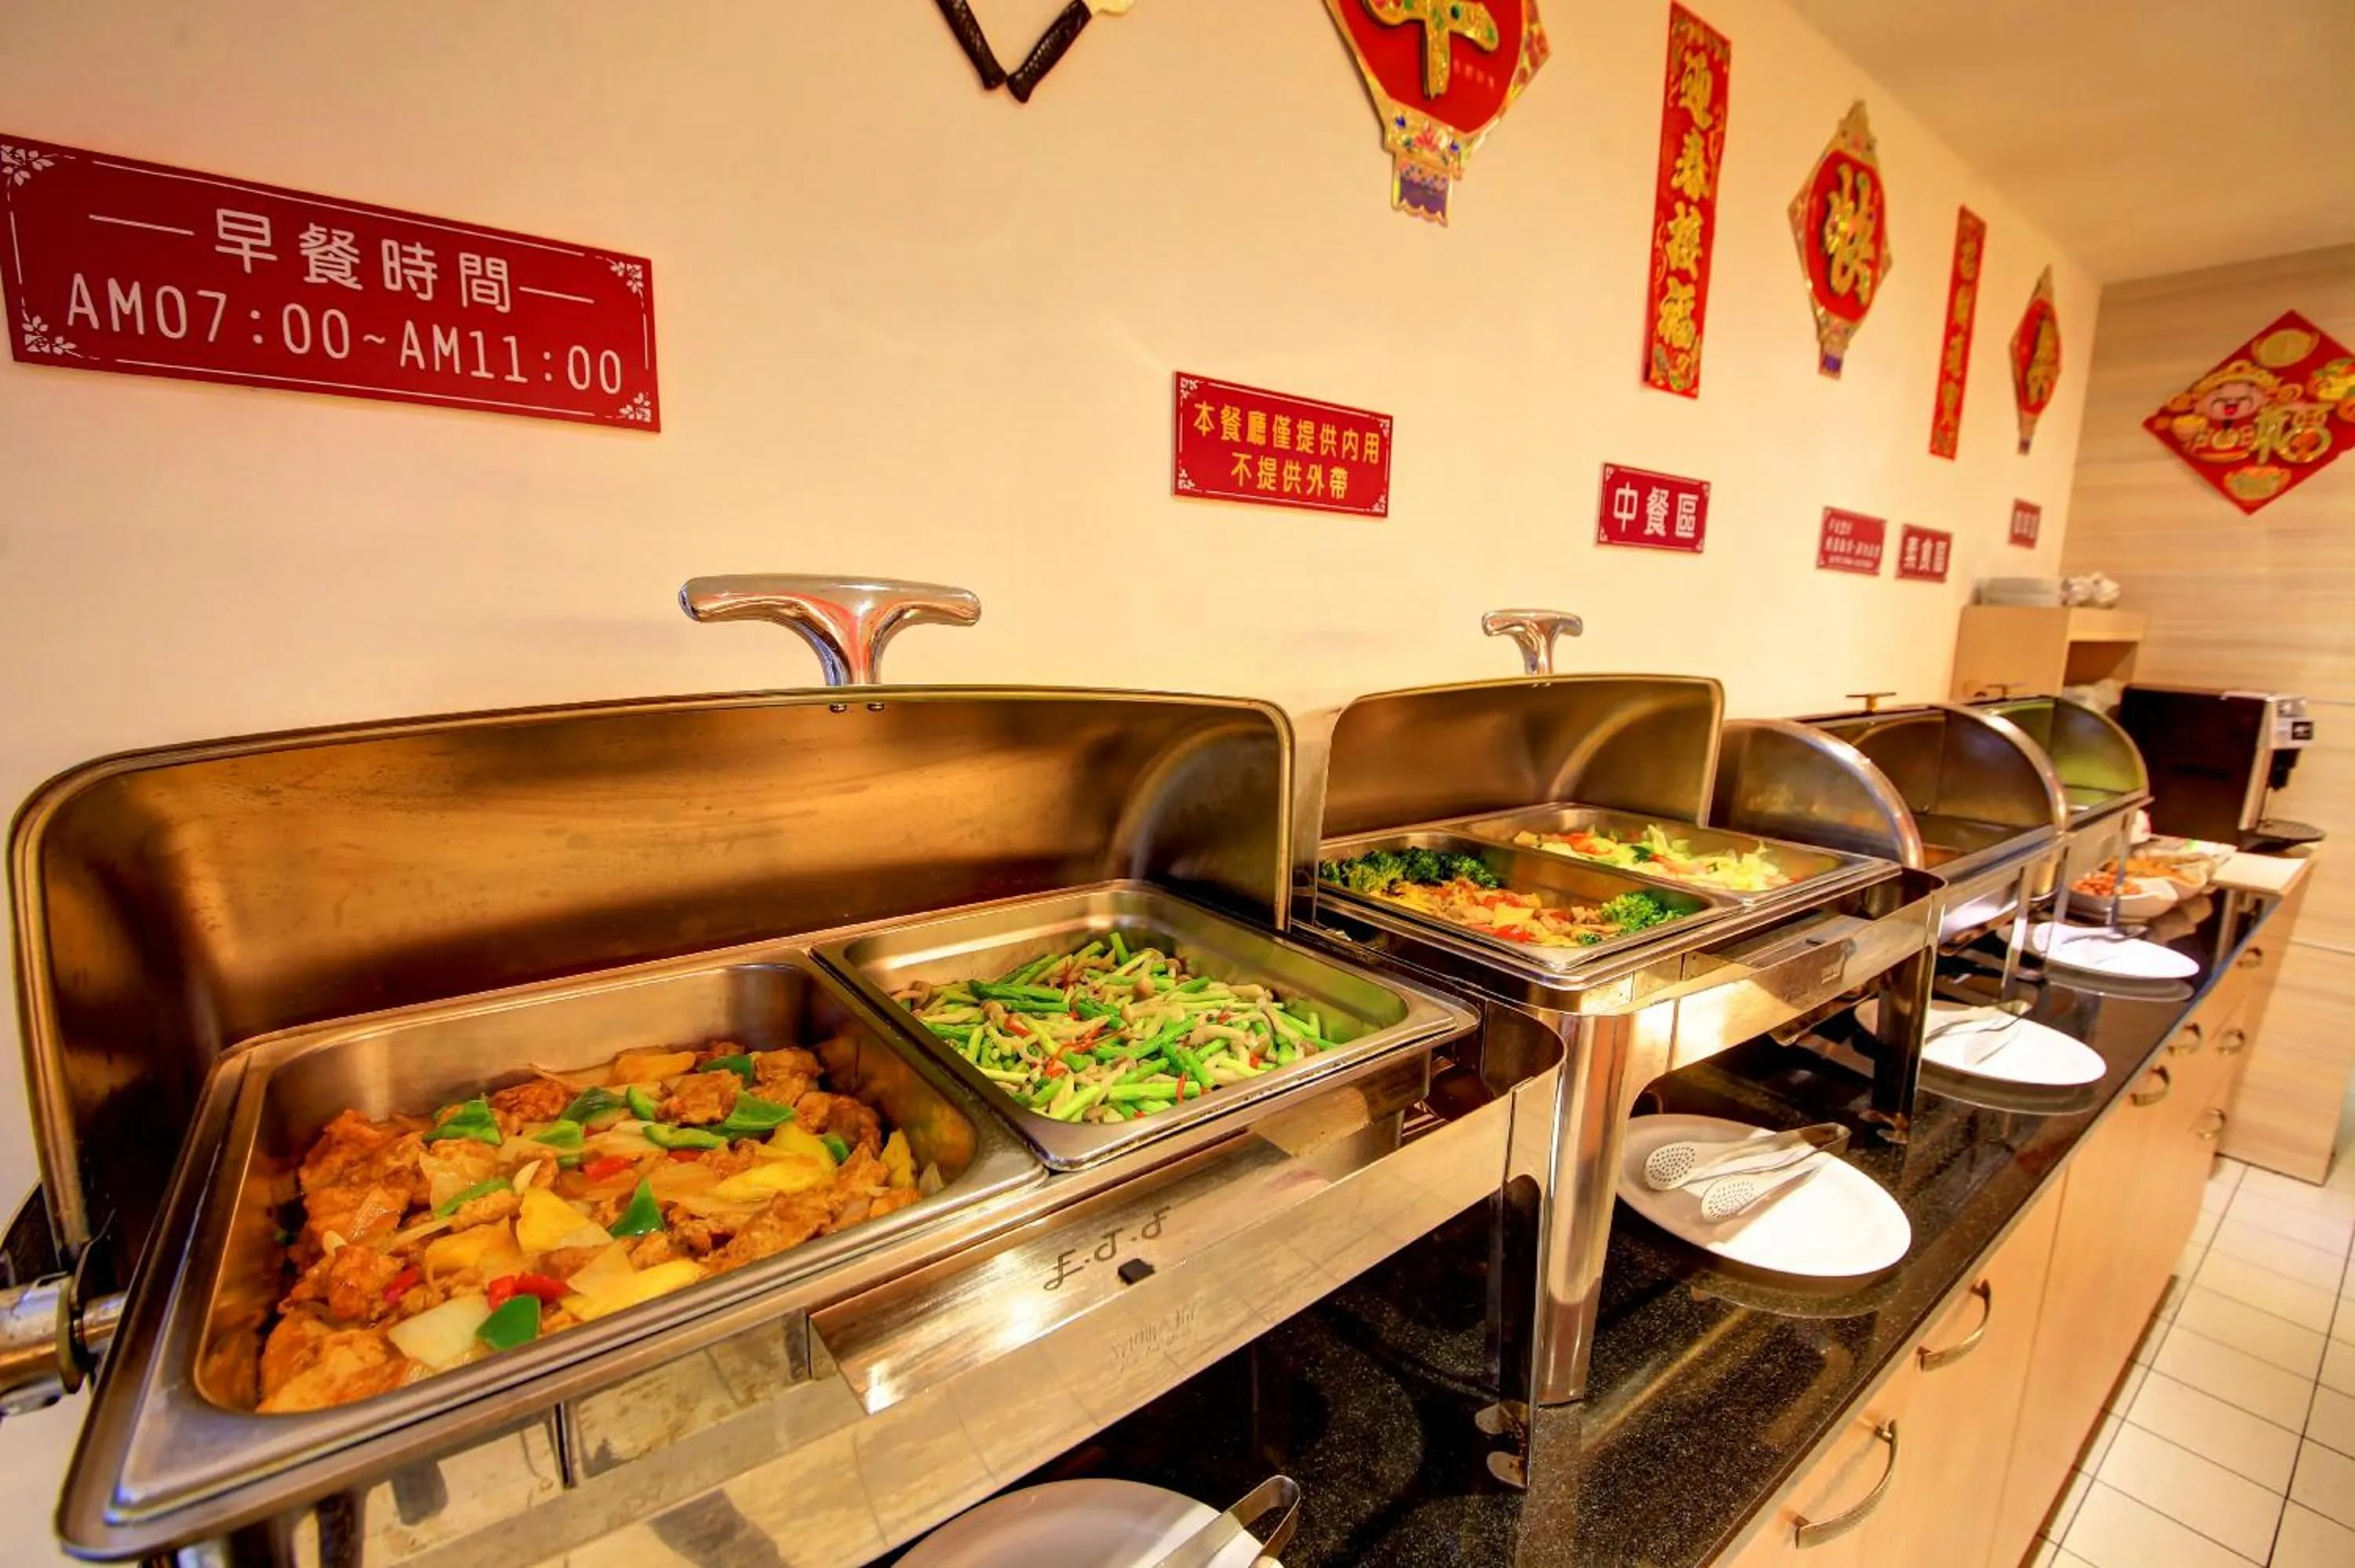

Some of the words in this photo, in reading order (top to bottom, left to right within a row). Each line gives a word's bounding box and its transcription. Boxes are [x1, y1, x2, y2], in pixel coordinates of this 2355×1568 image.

[214, 207, 511, 314] 早餐時間
[66, 272, 623, 395] AM07:00~AM11:00
[1192, 400, 1381, 465] 本餐廳僅提供內用
[1229, 451, 1349, 501] 不提供外帶
[1613, 480, 1700, 538] 中餐區
